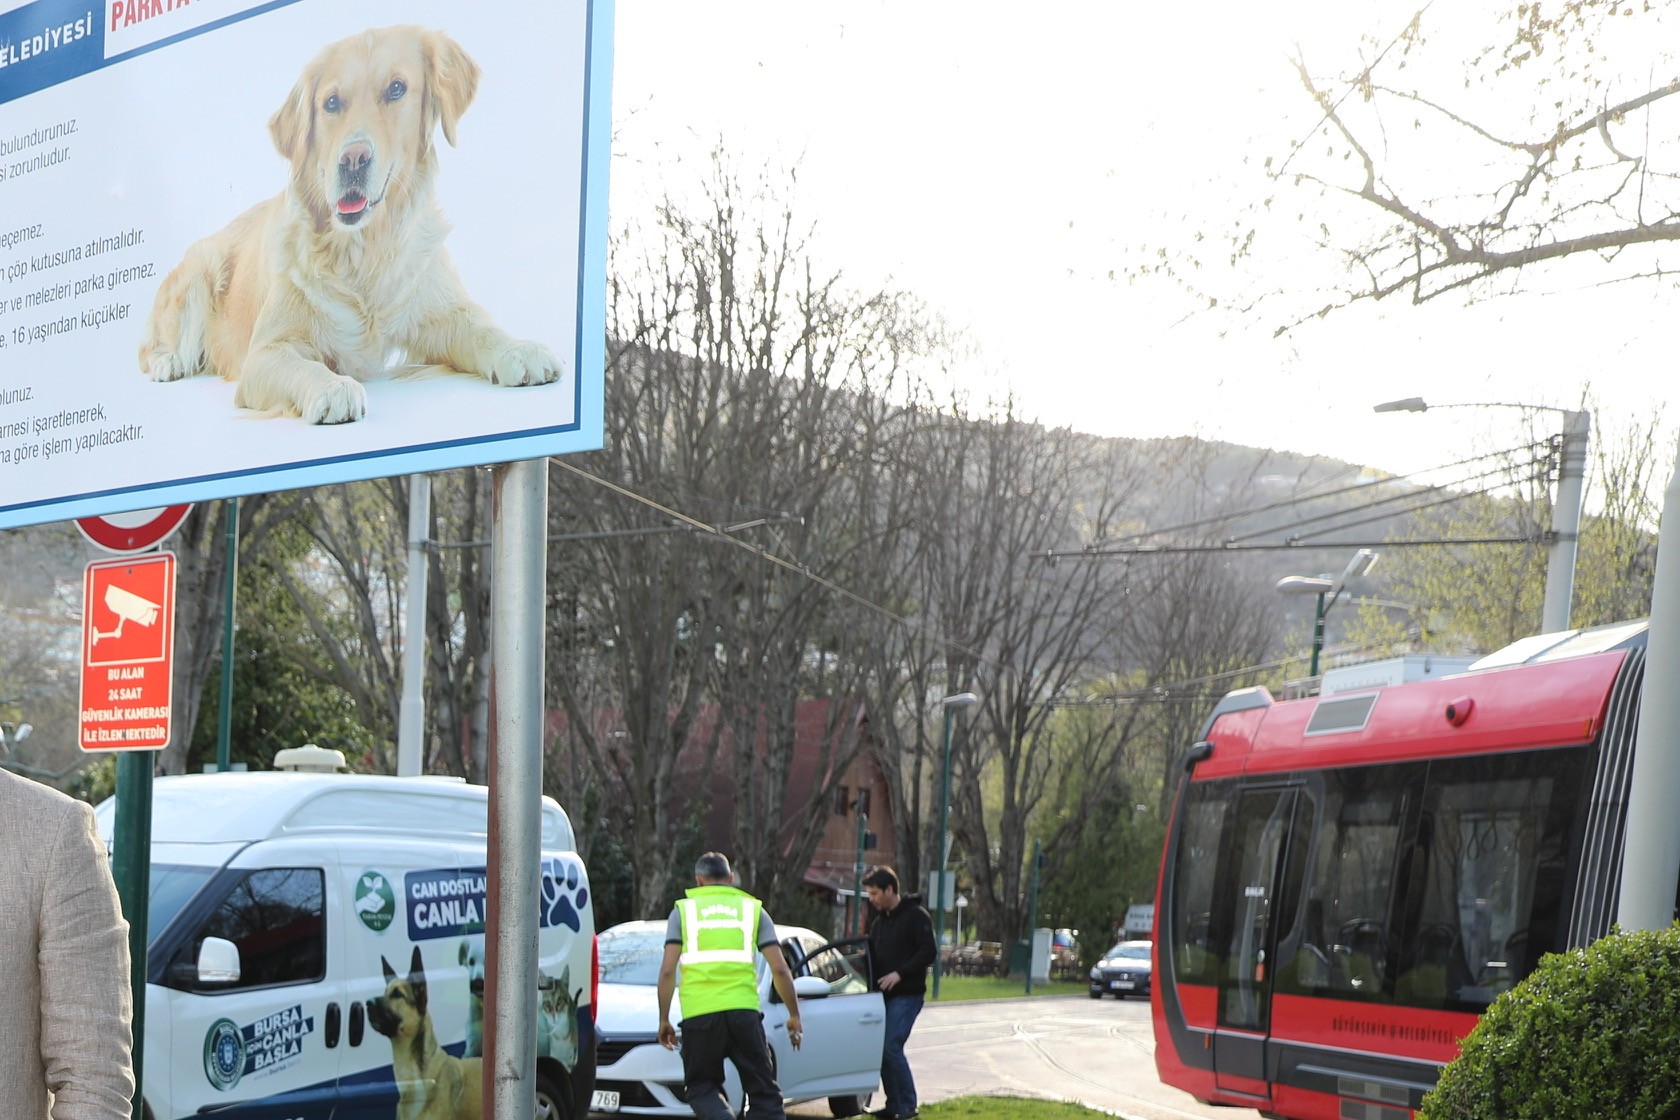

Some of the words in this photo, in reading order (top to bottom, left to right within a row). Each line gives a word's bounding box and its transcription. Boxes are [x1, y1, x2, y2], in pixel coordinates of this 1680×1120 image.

[0, 118, 78, 157] bulundurunuz.
[9, 146, 71, 179] zorunludur.
[7, 259, 28, 284] çöp
[30, 246, 82, 273] kutusuna
[84, 227, 144, 258] atılmalıdır.
[9, 296, 23, 312] ve
[24, 279, 71, 309] melezleri
[74, 273, 105, 300] parka
[106, 262, 156, 291] giremez.
[11, 325, 25, 345] 16
[26, 315, 78, 345] yaşından
[80, 302, 131, 330] küçükler
[30, 402, 107, 438] işaretlenerek,
[11, 441, 40, 465] göre
[41, 437, 72, 460] işlem
[74, 423, 144, 455] yapılacaktır.
[107, 668, 120, 681] BU
[121, 666, 145, 680] ALAN
[108, 688, 119, 701] 24
[119, 687, 143, 700] SAAT
[82, 705, 124, 722] GÜVENLİK
[124, 705, 168, 721] KAMERASI
[83, 727, 98, 742] İLE
[411, 880, 438, 899] CAN
[439, 876, 487, 896] DOSTLA
[413, 898, 480, 930] CANLA
[253, 1007, 300, 1037] BURSA
[262, 1020, 310, 1050] CANLA
[254, 1040, 300, 1070] BAŞLA
